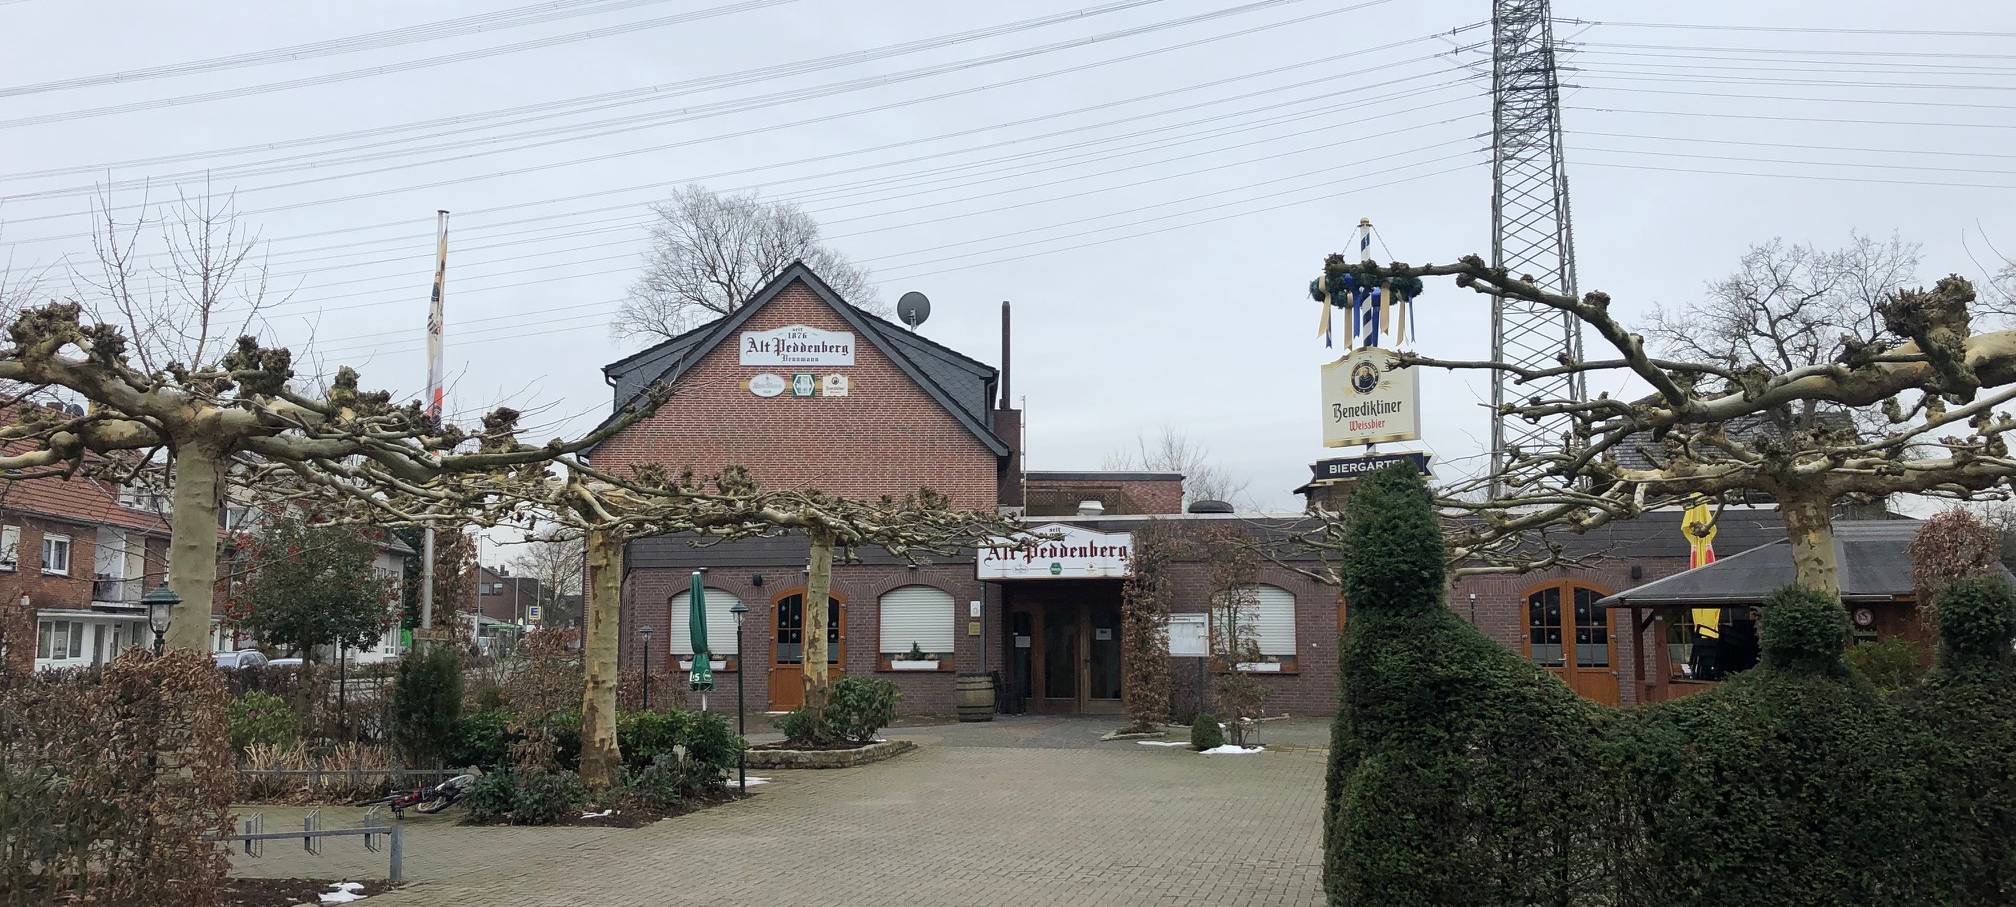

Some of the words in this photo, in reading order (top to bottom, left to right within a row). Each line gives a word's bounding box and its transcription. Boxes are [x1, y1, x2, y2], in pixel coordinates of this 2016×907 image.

[746, 337, 771, 356] Alt
[772, 337, 849, 356] Peddenberg
[1332, 400, 1402, 423] Benediktiner
[1349, 419, 1386, 432] Weissbier
[1329, 459, 1405, 474] BIERGART
[984, 543, 1017, 567] Alt
[1022, 539, 1128, 564] Peddenberg
